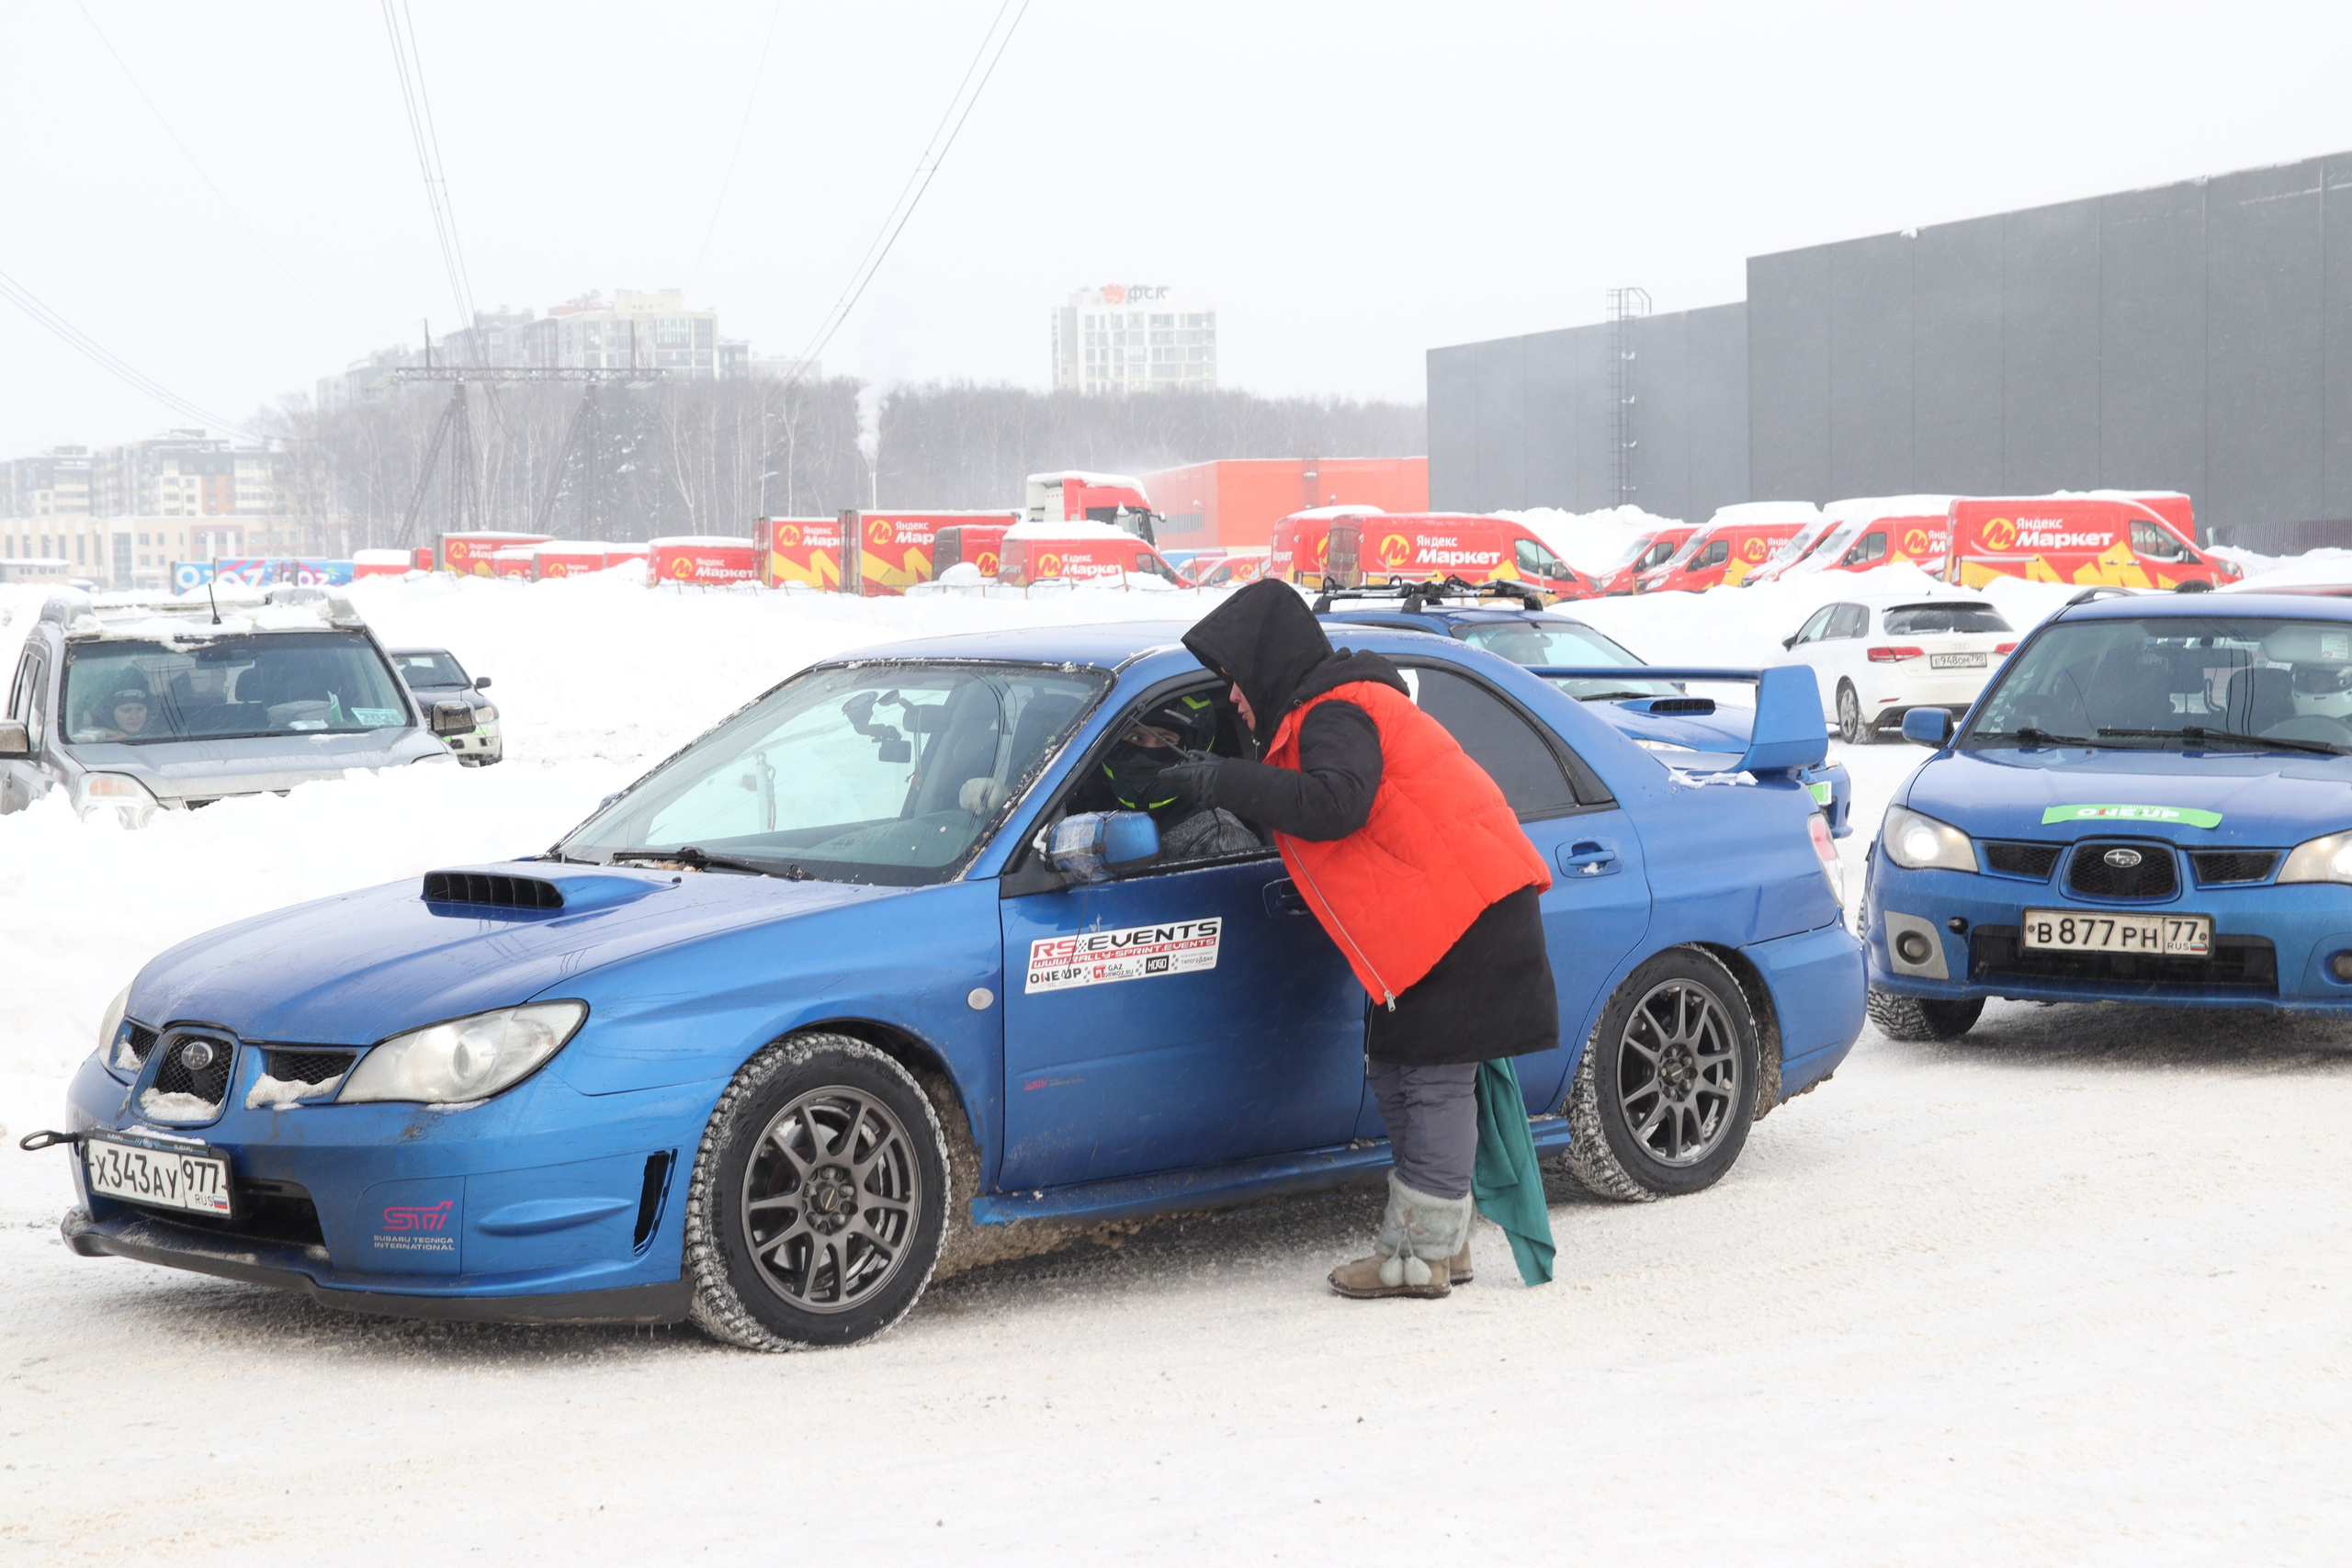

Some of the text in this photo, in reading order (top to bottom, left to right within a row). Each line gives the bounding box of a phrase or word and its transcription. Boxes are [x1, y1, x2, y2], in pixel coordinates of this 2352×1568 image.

[802, 525, 833, 536] Яндекс
[895, 521, 929, 531] Яндекс
[2015, 517, 2063, 531] Яндекс
[469, 542, 492, 550] Яндекс
[1416, 535, 1458, 548] Яндекс
[2015, 531, 2113, 548] Маркет
[695, 558, 725, 568] Яндекс
[1415, 548, 1501, 565] Маркет
[695, 567, 754, 580] Маркет
[1061, 563, 1123, 576] Маркет
[2168, 920, 2199, 942] 77
[2167, 942, 2189, 951] RUS
[96, 1148, 220, 1200] Х343АУ 977
[195, 1193, 214, 1208] RUS
[373, 1235, 412, 1243] SUBARU
[374, 1242, 456, 1251] INTERNATIONAL
